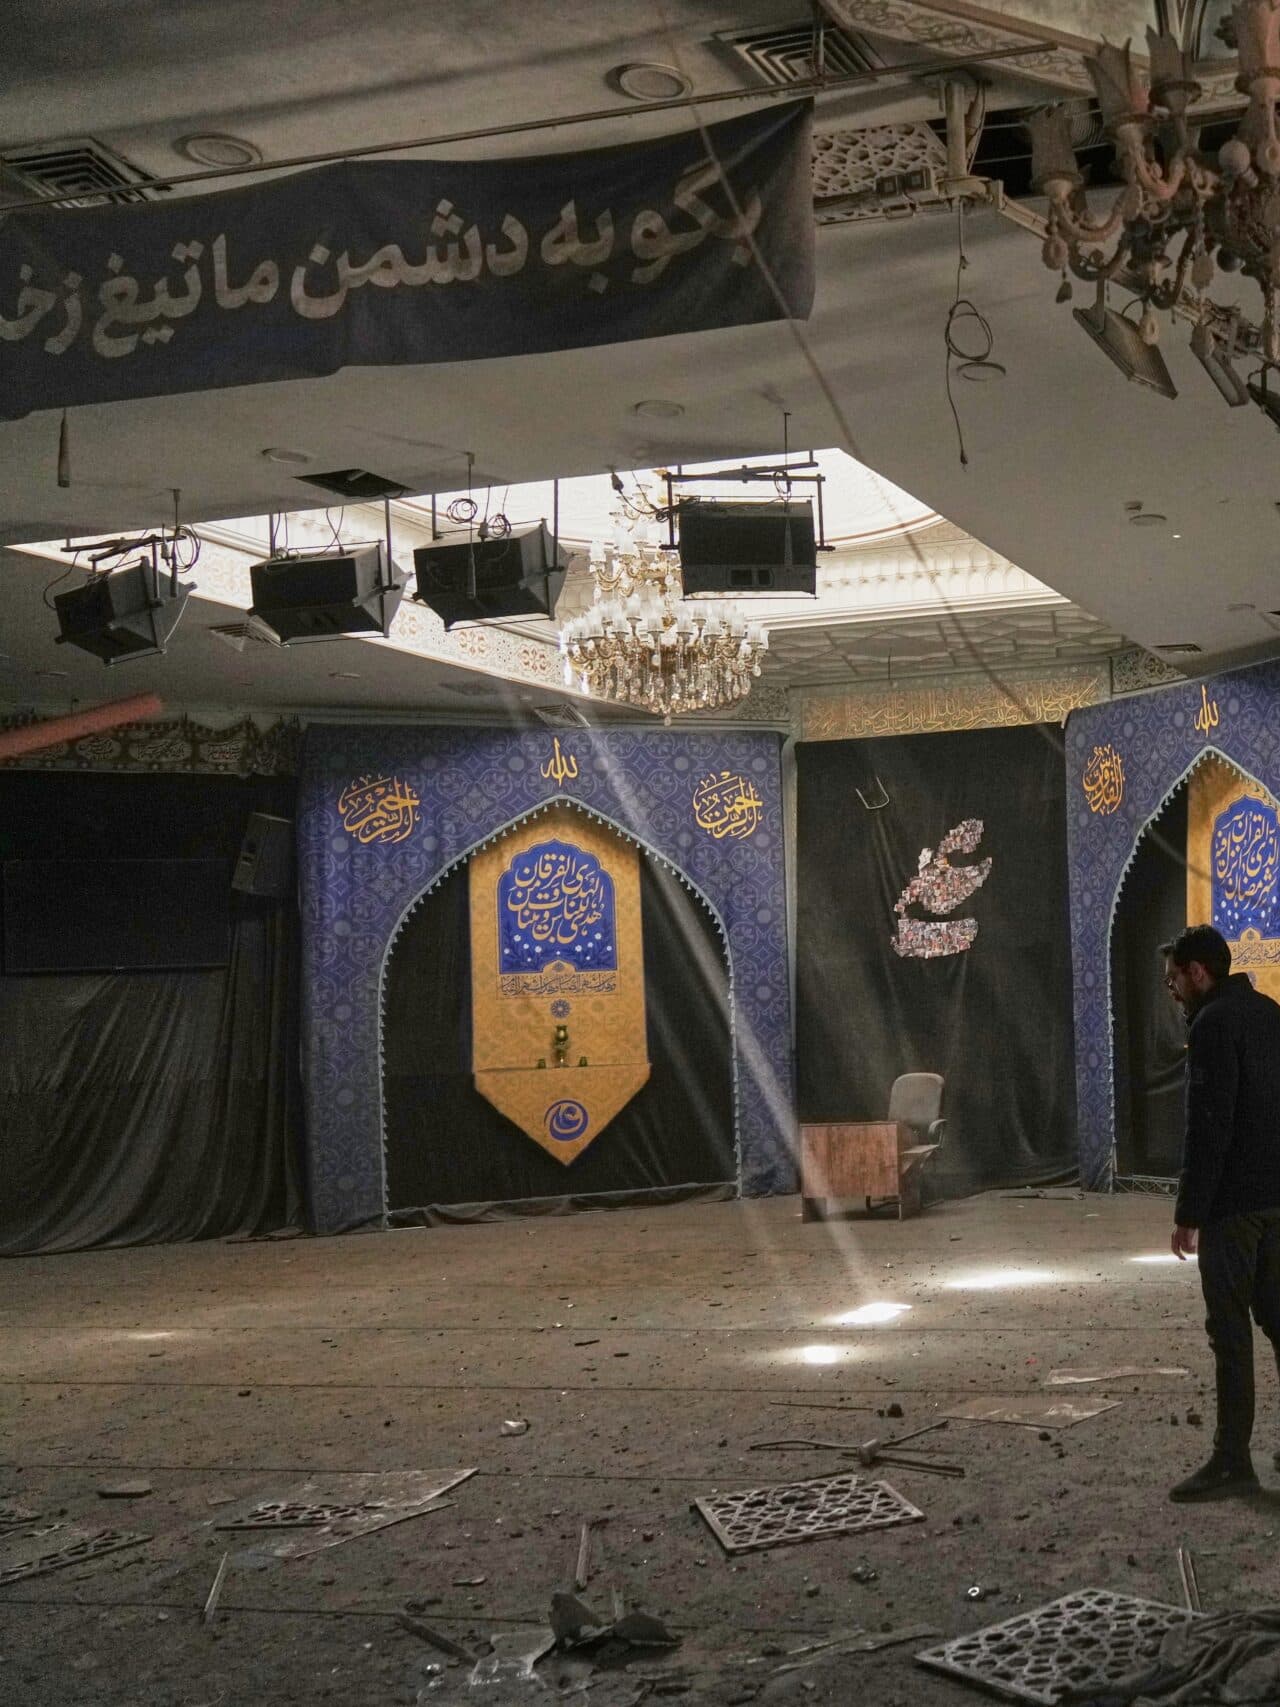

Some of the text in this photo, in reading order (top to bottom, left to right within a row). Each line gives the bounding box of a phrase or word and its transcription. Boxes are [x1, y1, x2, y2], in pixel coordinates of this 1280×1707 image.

[92, 238, 202, 359] تیغ
[212, 233, 279, 316] ما
[291, 197, 533, 320] دشمن
[539, 199, 614, 294] به
